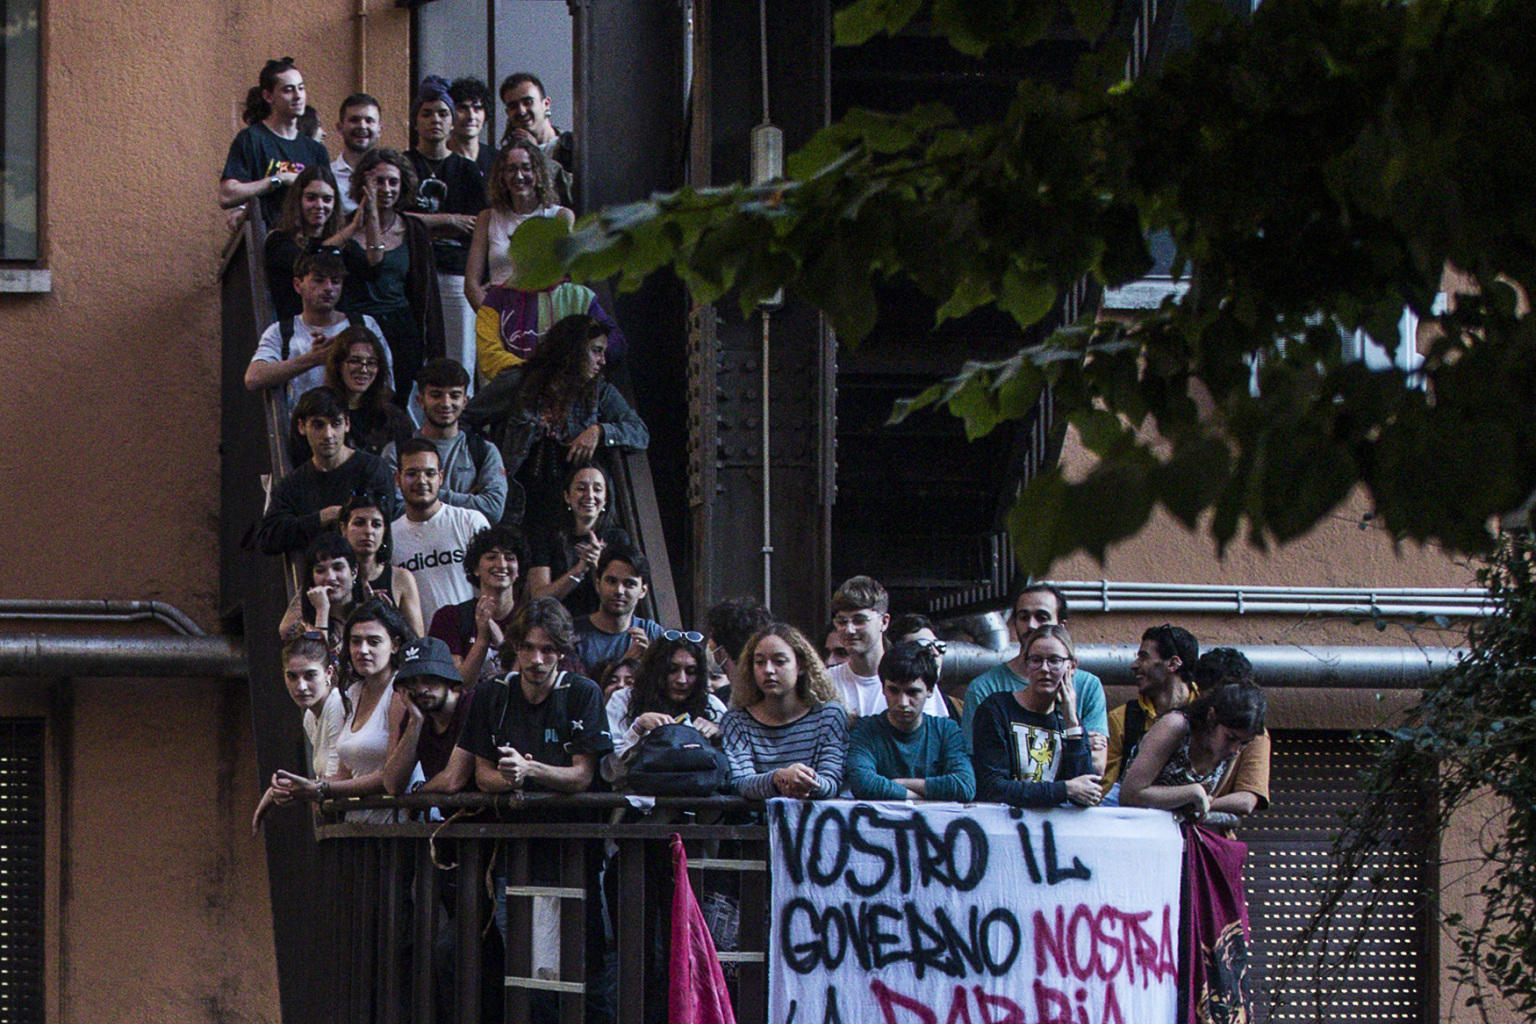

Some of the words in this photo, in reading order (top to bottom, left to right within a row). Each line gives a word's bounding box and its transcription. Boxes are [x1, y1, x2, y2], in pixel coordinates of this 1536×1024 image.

[775, 800, 989, 897] VOSTRO
[781, 898, 1021, 979] GOVERNO
[1033, 903, 1179, 990] NOSTRA
